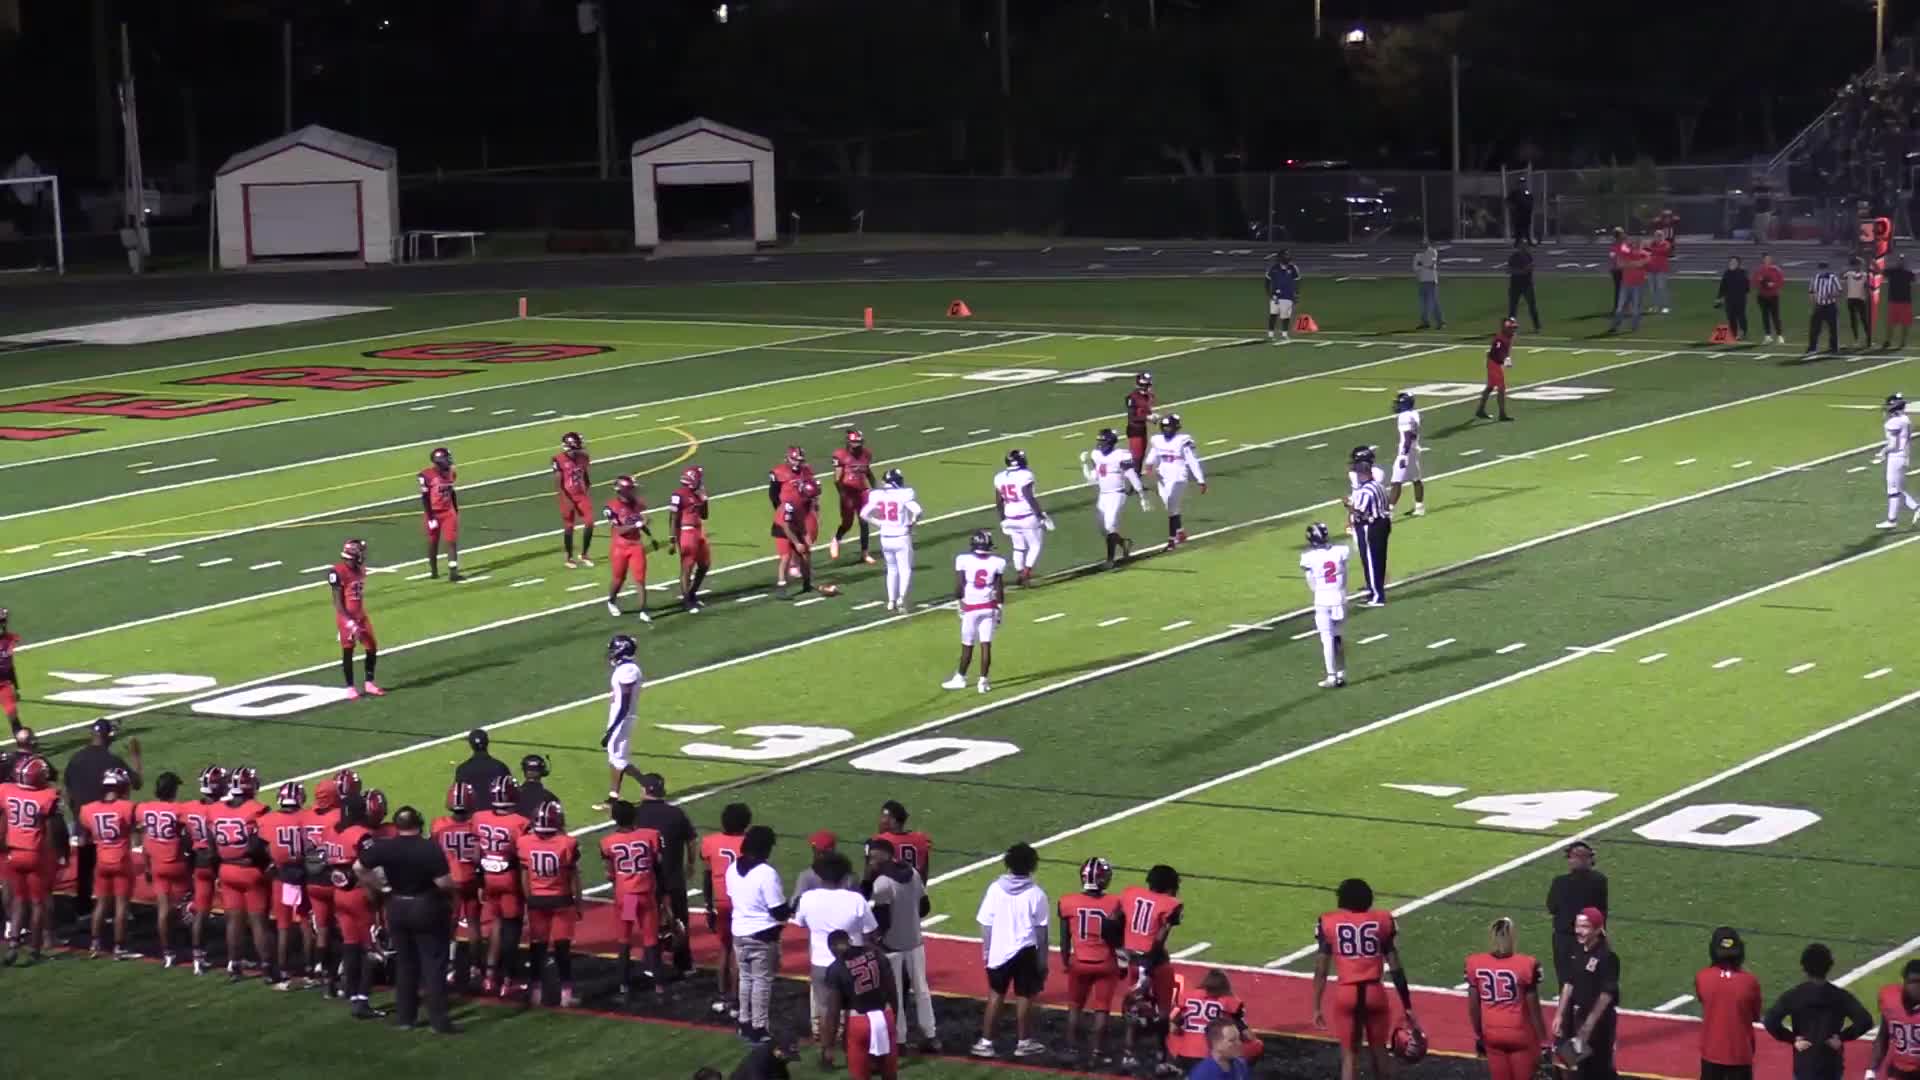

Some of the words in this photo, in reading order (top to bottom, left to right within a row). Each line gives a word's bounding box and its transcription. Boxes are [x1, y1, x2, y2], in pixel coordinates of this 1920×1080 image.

[974, 569, 988, 590] 6
[1323, 560, 1337, 584] 2
[7, 796, 40, 830] 39
[93, 812, 120, 843] 15
[531, 849, 561, 878] 10
[611, 841, 649, 874] 22
[1132, 897, 1154, 935] 11
[1336, 921, 1380, 960] 86
[850, 958, 880, 995] 21
[1475, 968, 1519, 1002] 33
[1183, 999, 1225, 1033] 29
